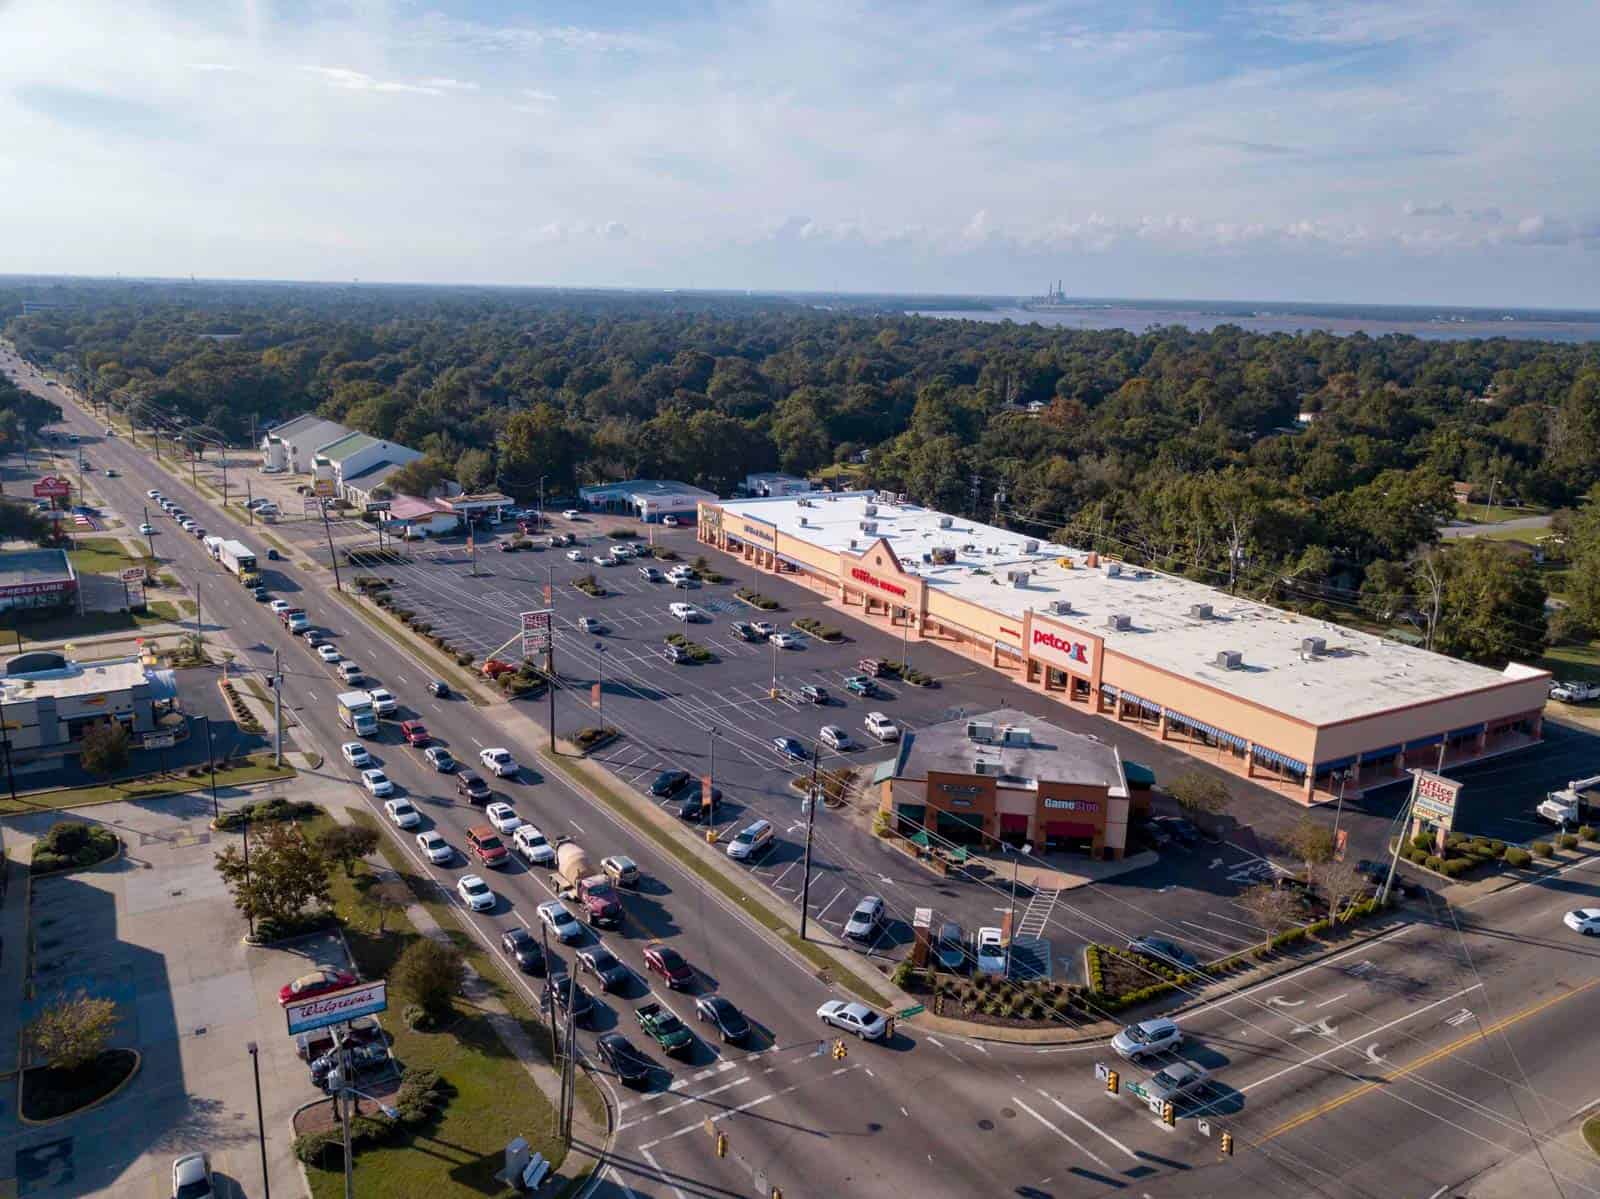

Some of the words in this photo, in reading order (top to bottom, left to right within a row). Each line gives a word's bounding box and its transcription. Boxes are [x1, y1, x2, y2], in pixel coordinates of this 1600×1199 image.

[1034, 630, 1071, 652] petco
[1419, 778, 1453, 797] Office
[1045, 798, 1099, 812] GameStop
[302, 992, 374, 1017] Walgreens
